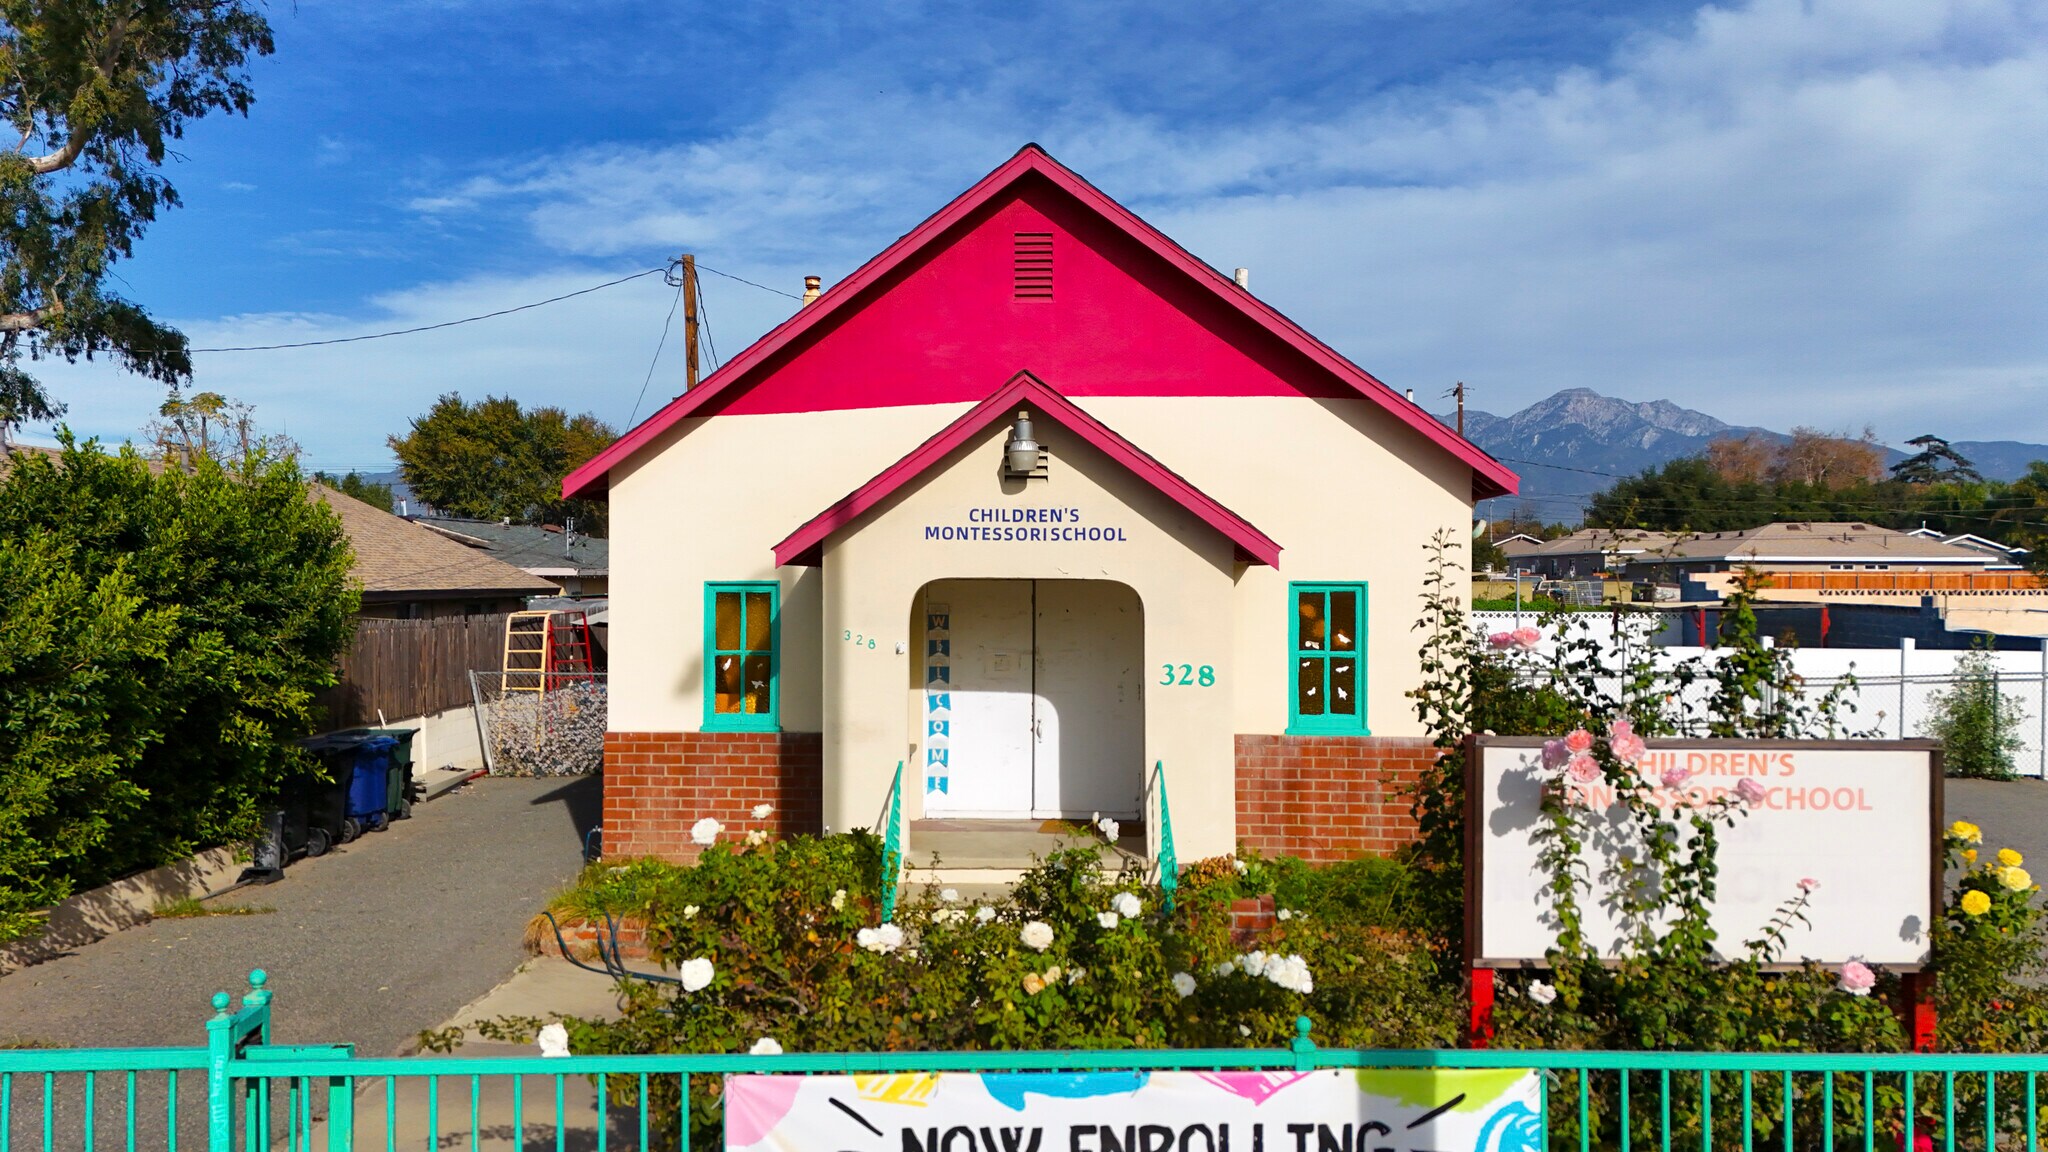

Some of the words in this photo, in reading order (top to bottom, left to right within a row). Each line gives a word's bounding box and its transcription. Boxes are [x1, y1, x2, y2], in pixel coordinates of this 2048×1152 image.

[969, 507, 1080, 523] CHILDREN'S
[844, 629, 876, 650] 328
[1159, 663, 1216, 687] 328
[1622, 752, 1796, 776] HIDREN'S
[1750, 786, 1873, 811] CHOOL
